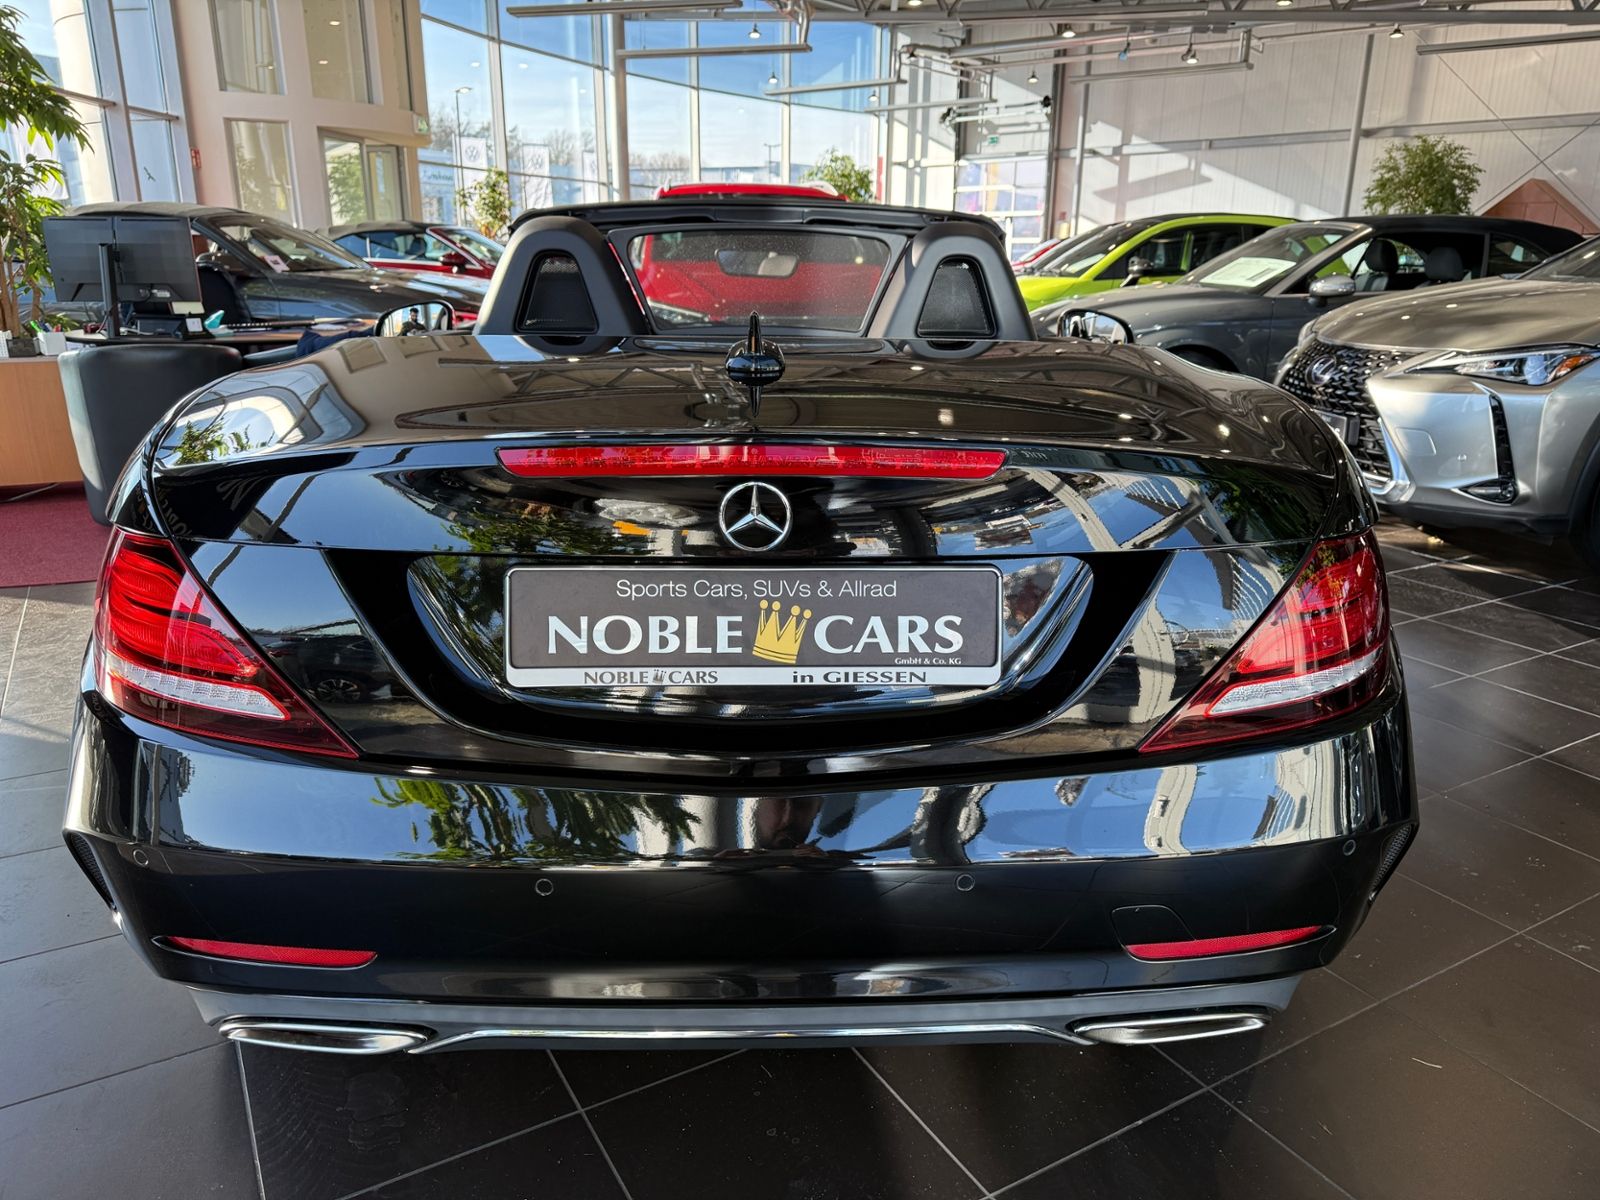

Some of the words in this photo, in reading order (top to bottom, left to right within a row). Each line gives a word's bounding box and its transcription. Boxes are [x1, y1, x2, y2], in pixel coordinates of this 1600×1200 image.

[616, 579, 687, 600] Sports
[694, 579, 748, 600] Cars,
[753, 579, 811, 597] SUVs
[817, 580, 833, 597] &
[838, 580, 897, 597] Allrad
[548, 614, 743, 655] NOBLE
[813, 614, 964, 654] CARS
[894, 657, 922, 665] GmbH
[923, 657, 931, 665] &
[932, 657, 947, 665] Co.
[948, 657, 962, 665] KG
[584, 671, 649, 684] NOBLE
[668, 670, 719, 684] CARS
[792, 670, 814, 683] in
[822, 671, 927, 683] GIESSEN
